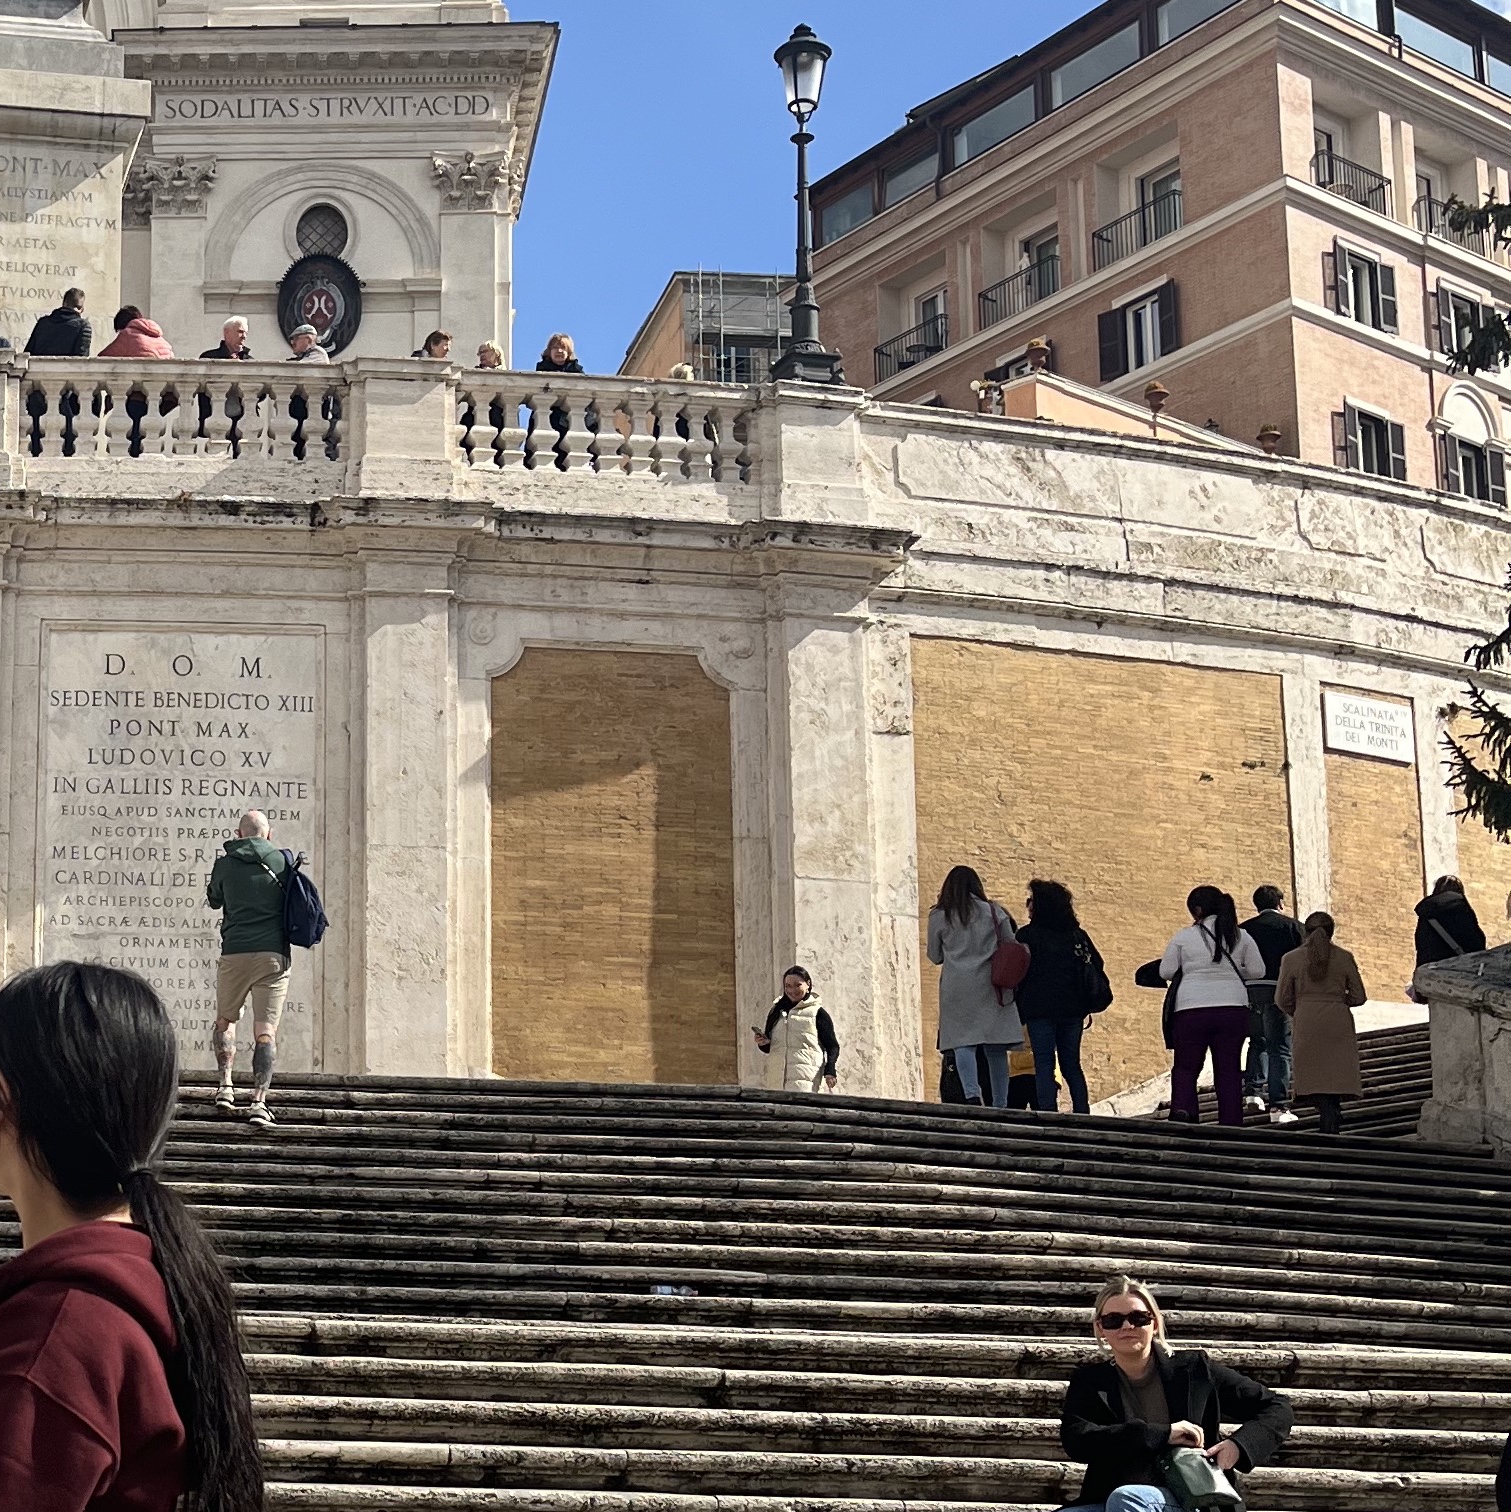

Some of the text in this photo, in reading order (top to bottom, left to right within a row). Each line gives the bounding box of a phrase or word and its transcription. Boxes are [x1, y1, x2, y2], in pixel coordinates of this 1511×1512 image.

[164, 97, 300, 119] SODALITAS
[307, 95, 414, 118] STRVXIT
[26, 212, 117, 230] DIFFRACTVM
[50, 690, 314, 713] SEDENTE BENEDICTO XIII
[1343, 702, 1395, 722] SCALINATA
[1335, 715, 1365, 730] DELLA
[1345, 731, 1399, 751] DEI MONTI
[88, 748, 272, 768] LUDOVICO XV
[53, 776, 308, 799] IN GALLIIS REGNANTE
[115, 806, 158, 817] APUD
[166, 807, 241, 819] SANCTAM
[92, 826, 169, 839] NEGOTIIS
[52, 845, 171, 863] MELCHIORE
[55, 870, 165, 887] CARDINALI
[172, 873, 197, 888] DE
[63, 895, 195, 908] ARCHIEPISCOPO
[49, 915, 72, 926] AD
[109, 956, 169, 969] CIVIUM
